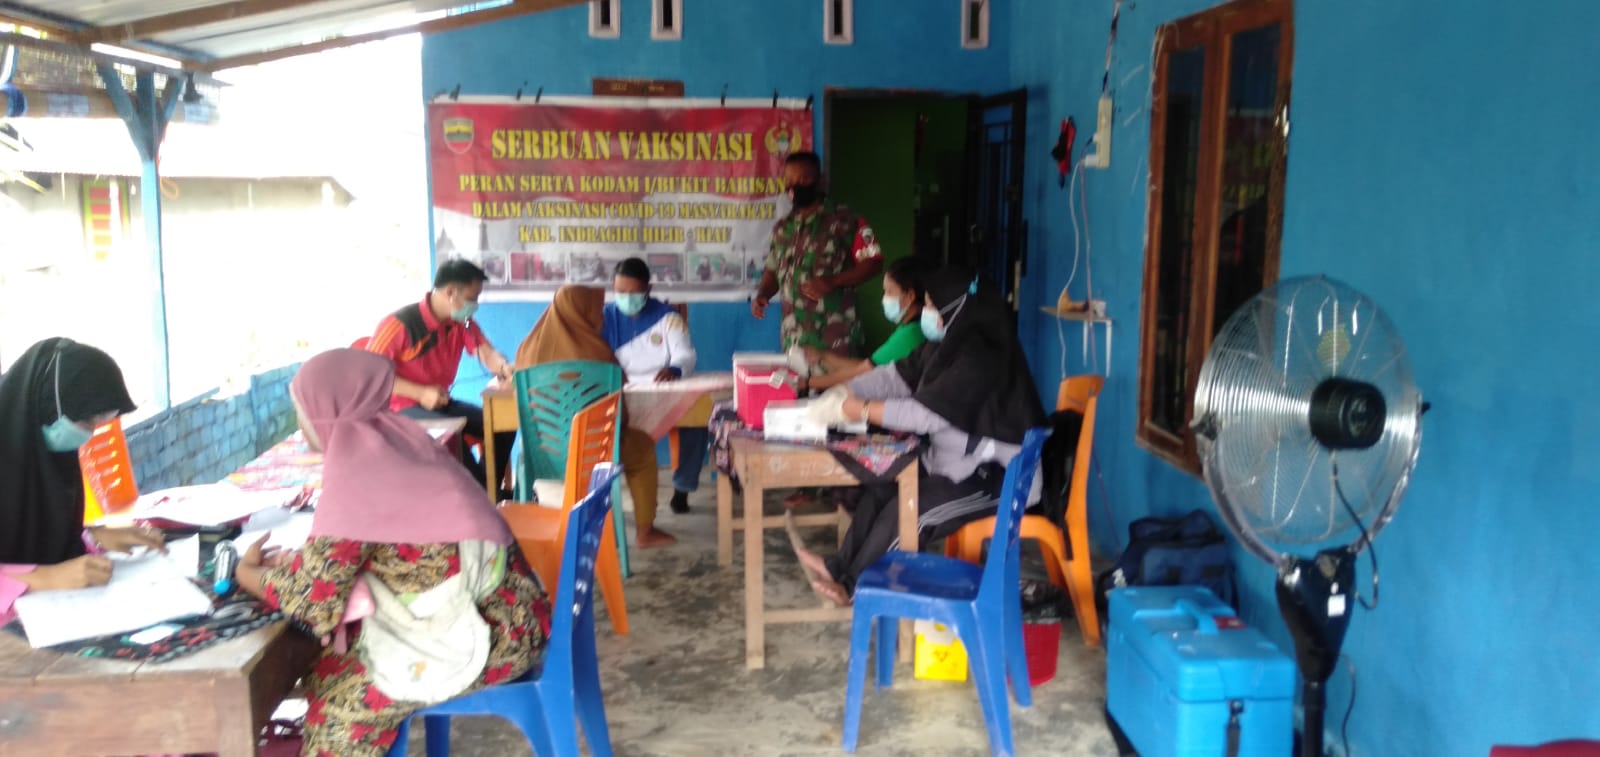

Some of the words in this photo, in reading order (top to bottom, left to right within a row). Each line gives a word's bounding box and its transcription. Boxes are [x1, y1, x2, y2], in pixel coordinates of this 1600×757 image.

[491, 129, 611, 160] SERBUAN
[618, 131, 753, 161] VAKSINASI
[459, 175, 515, 192] PERAN
[520, 175, 575, 192] SERTA
[580, 175, 639, 193] KODAM
[715, 177, 786, 194] BARISAN
[472, 202, 522, 218] DALAM
[525, 202, 606, 218] VAKSINASI
[678, 202, 775, 219] MASYARAKAT
[519, 226, 556, 242] KAB.
[559, 226, 639, 243] INDRAGIRI
[643, 227, 684, 243] HILIR
[695, 227, 731, 243] RIAU
